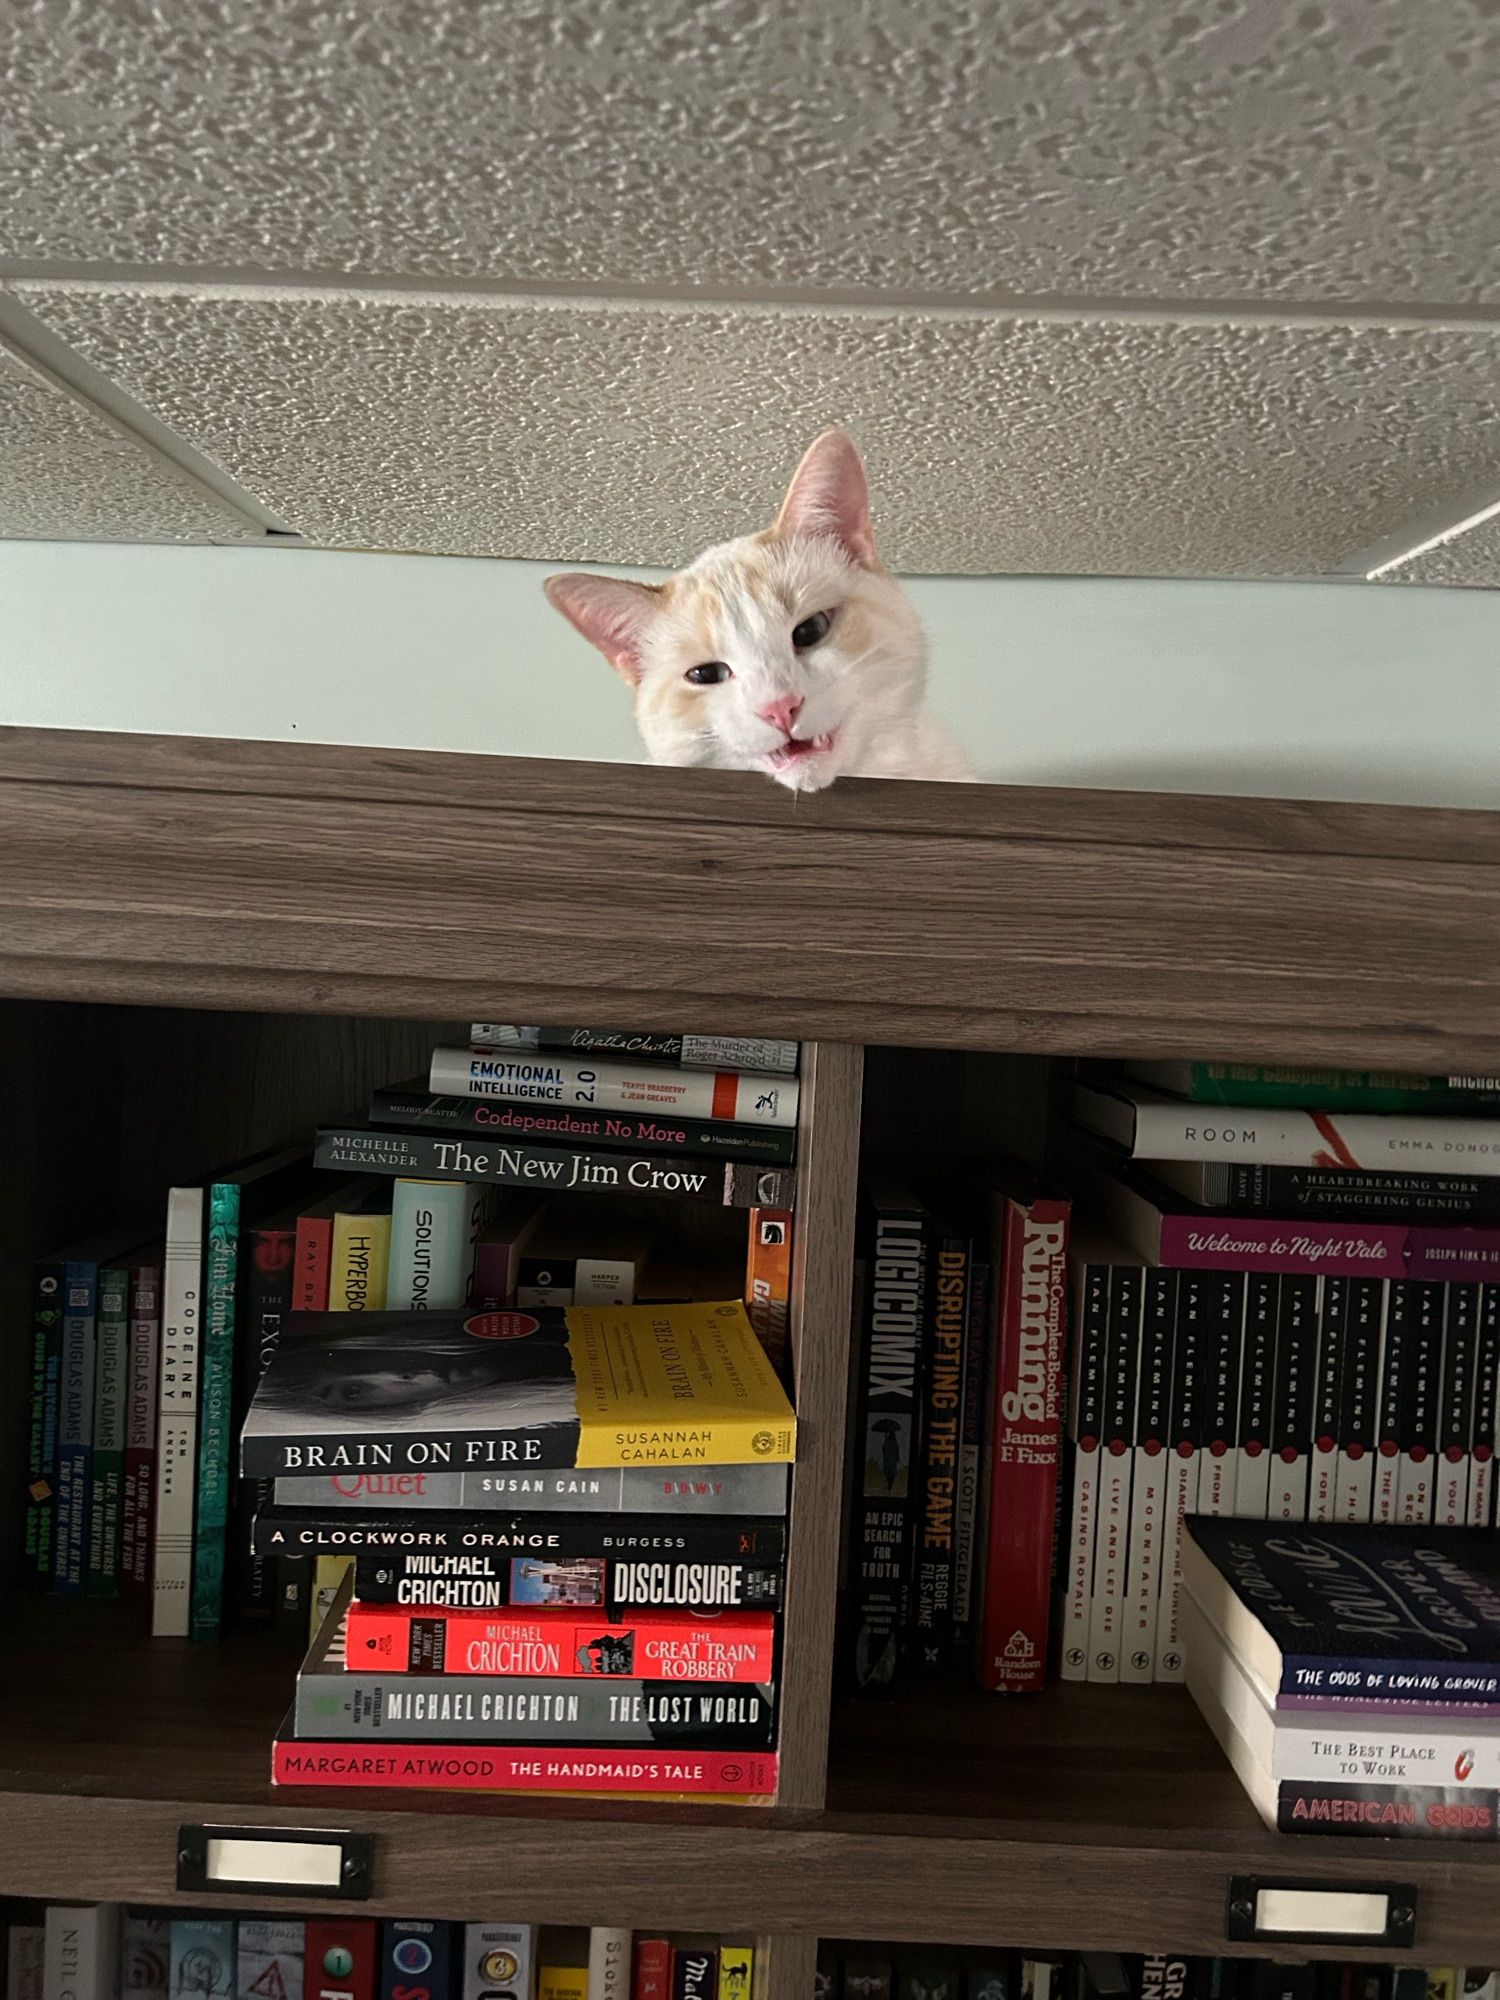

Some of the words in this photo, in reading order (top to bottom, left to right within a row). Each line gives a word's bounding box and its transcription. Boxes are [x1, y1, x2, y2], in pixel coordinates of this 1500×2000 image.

[570, 1029, 626, 1050] Agatha
[626, 1037, 681, 1054] Christie
[686, 1049, 722, 1062] Roger
[724, 1051, 765, 1066] Ackroyd
[689, 1037, 707, 1048] The
[710, 1039, 748, 1052] Murder
[752, 1043, 764, 1052] of
[469, 1081, 563, 1100] INTELLIGENCE
[470, 1061, 563, 1085] EMOTIONAL
[576, 1070, 596, 1102] 2.0
[474, 1107, 600, 1135] Codependent
[604, 1119, 633, 1139] No
[636, 1123, 687, 1145] More
[1185, 1127, 1257, 1143] ROOM
[330, 1150, 418, 1167] ALEXANDER
[332, 1137, 409, 1152] MICHELLE
[434, 1142, 489, 1173] The
[497, 1149, 564, 1179] New
[567, 1155, 619, 1187] Jim
[620, 1161, 708, 1193] Crow
[1290, 1173, 1300, 1184] A
[1306, 1173, 1430, 1191] HEARTBREAKING
[1437, 1179, 1480, 1194] WORK
[1297, 1189, 1312, 1204] of
[1317, 1191, 1410, 1207] STAGGERING
[1416, 1196, 1472, 1210] GENIUS
[306, 1240, 317, 1272] RAY
[1188, 1232, 1268, 1254] Welcome
[1269, 1237, 1289, 1254] to
[1289, 1236, 1344, 1262] Night
[1345, 1239, 1389, 1260] Vale
[1049, 1252, 1066, 1284] The
[868, 1218, 924, 1398] LOGICOMIX
[1091, 1278, 1101, 1313] IAN
[1121, 1281, 1131, 1316] IAN
[1156, 1281, 1166, 1316] IAN
[1188, 1284, 1198, 1319] IAN
[1221, 1283, 1232, 1318] IAN
[1257, 1284, 1268, 1319] IAN
[1292, 1291, 1302, 1326] IAN
[1330, 1280, 1339, 1316] IAN
[1360, 1287, 1370, 1323] IAN
[1394, 1284, 1404, 1320] IAN
[1421, 1289, 1431, 1326] IAN
[1457, 1289, 1467, 1326] IAN
[1486, 1289, 1496, 1325] IAN
[652, 1320, 675, 1344] FIRE
[931, 1250, 966, 1409] DISRUPTING
[1001, 1219, 1066, 1423] Running
[1045, 1284, 1065, 1360] Complete
[68, 1320, 85, 1387] DOUGLAS
[102, 1327, 118, 1393] DOUGLAS
[135, 1324, 151, 1391] DOUGLAS
[181, 1290, 197, 1399] CODEINE
[659, 1346, 681, 1361] ON
[164, 1327, 178, 1399] DIARY
[721, 1355, 749, 1399] SUSANNAH
[1085, 1329, 1098, 1422] FLEMING
[1114, 1333, 1128, 1426] FLEMING
[1150, 1333, 1163, 1426] FLEMING
[1215, 1334, 1229, 1427] FLEMING
[1324, 1332, 1337, 1423] FLEMING
[209, 1363, 224, 1420] ALISON
[664, 1363, 695, 1399] BRAIN
[1046, 1360, 1062, 1403] Book
[1182, 1335, 1195, 1428] FLEMING
[1251, 1335, 1265, 1427] FLEMING
[1286, 1341, 1299, 1433] FLEMING
[1352, 1339, 1367, 1431] FLEMING
[1386, 1336, 1401, 1427] FLEMING
[1415, 1341, 1428, 1433] FLEMING
[1450, 1340, 1464, 1433] FLEMING
[1479, 1340, 1494, 1432] FLEMING
[65, 1391, 81, 1441] ADAMS
[99, 1398, 115, 1447] ADAMS
[131, 1396, 148, 1445] ADAMS
[1045, 1403, 1060, 1420] of
[179, 1430, 189, 1457] TOM
[283, 1443, 393, 1469] BRAIN
[406, 1441, 453, 1465] ON
[464, 1438, 542, 1464] FIRE
[615, 1431, 712, 1446] SUSANNAH
[927, 1416, 959, 1467] THE
[1001, 1427, 1057, 1445] James
[164, 1430, 175, 1495] ANDREWS
[206, 1427, 221, 1497] BECHDEL
[619, 1447, 706, 1461] CAHALAN
[483, 1479, 545, 1493] SUSAN
[556, 1480, 600, 1493] CAIN
[960, 1465, 974, 1515] SCOTT
[1110, 1478, 1121, 1515] LIVE
[1211, 1464, 1222, 1504] FROM
[923, 1475, 955, 1550] GAME
[1078, 1480, 1091, 1546] CASINO
[270, 1531, 285, 1544] A
[298, 1530, 448, 1546] CLOCKWORK
[462, 1533, 561, 1548] ORANGE
[603, 1536, 686, 1549] BURGESS
[1107, 1525, 1118, 1559] AND
[404, 1555, 496, 1576] MICHAEL
[953, 1520, 972, 1617] FITZGERALD
[1139, 1487, 1155, 1630] MOONRAKER
[397, 1579, 501, 1606] CRICHTON
[613, 1562, 743, 1605] DISCLOSURE
[933, 1563, 950, 1611] REGGIE
[1073, 1556, 1085, 1620] ROYALE
[1105, 1569, 1115, 1596] LET
[1380, 1558, 1476, 1630] GROVER
[412, 1624, 423, 1645] YORK
[485, 1624, 541, 1642] MICHAEL
[690, 1631, 711, 1641] THE
[1103, 1606, 1113, 1633] DIE
[411, 1646, 422, 1665] NEW
[432, 1622, 445, 1670] BESTSELLER
[466, 1641, 560, 1672] CRICHTON
[644, 1641, 701, 1660] GREAT
[707, 1643, 757, 1661] TRAIN
[994, 1657, 1041, 1669] Random
[661, 1660, 737, 1679] ROBBERY
[1000, 1668, 1036, 1681] House
[1296, 1669, 1323, 1687] THE
[1328, 1671, 1362, 1687] ODDS
[1366, 1674, 1384, 1688] OF
[1443, 1677, 1498, 1693] GROVER
[387, 1692, 474, 1720] MICHAEL
[480, 1694, 578, 1722] CRICHTON
[608, 1696, 640, 1722] THE
[646, 1696, 692, 1723] LOST
[698, 1696, 760, 1724] WORLD
[284, 1757, 398, 1776] MARGARET
[406, 1758, 495, 1777] ATWOOD
[1311, 1740, 1342, 1757] THE
[1347, 1742, 1384, 1759] BEST
[1390, 1743, 1436, 1761] PLACE
[510, 1760, 542, 1776] THE
[547, 1761, 660, 1778] HANDMAID'S
[664, 1763, 704, 1780] TALE
[1339, 1764, 1358, 1777] TO
[1360, 1763, 1407, 1779] WORK
[1291, 1797, 1415, 1826] AMERICAN
[1425, 1803, 1492, 1829] GODS
[61, 1928, 78, 1976] NEIL
